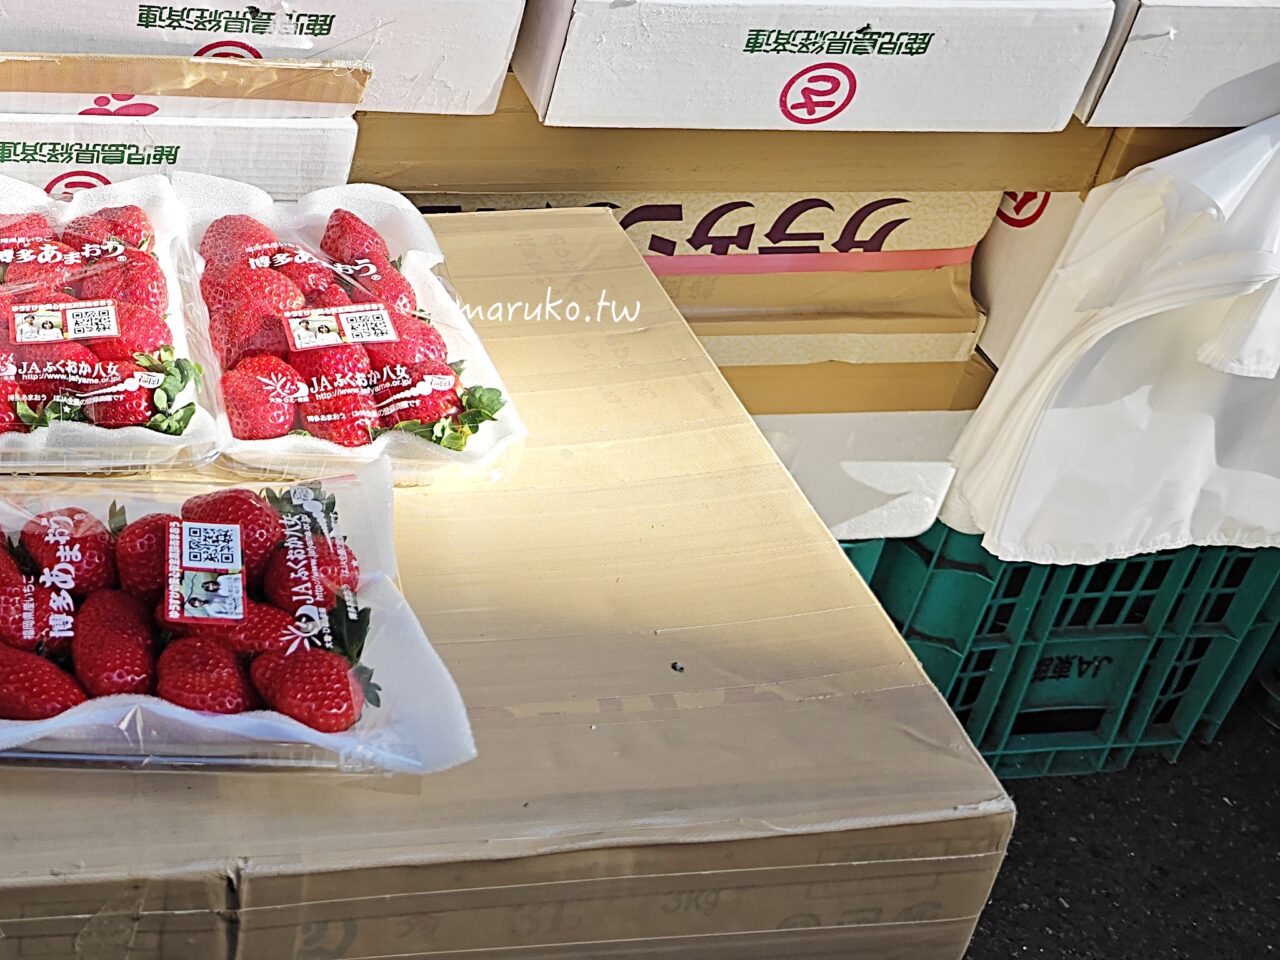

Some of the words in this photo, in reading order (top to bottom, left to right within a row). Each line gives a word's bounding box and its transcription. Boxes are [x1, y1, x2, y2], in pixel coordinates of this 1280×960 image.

[136, 3, 337, 37] 鹿児島県経済連
[742, 27, 936, 57] 鹿児島県経済連
[248, 250, 377, 278] 博多あおう
[17, 360, 120, 376] JAふくおか八女
[309, 364, 410, 394] JAふくおか八女
[279, 512, 315, 605] JAふくおか八女
